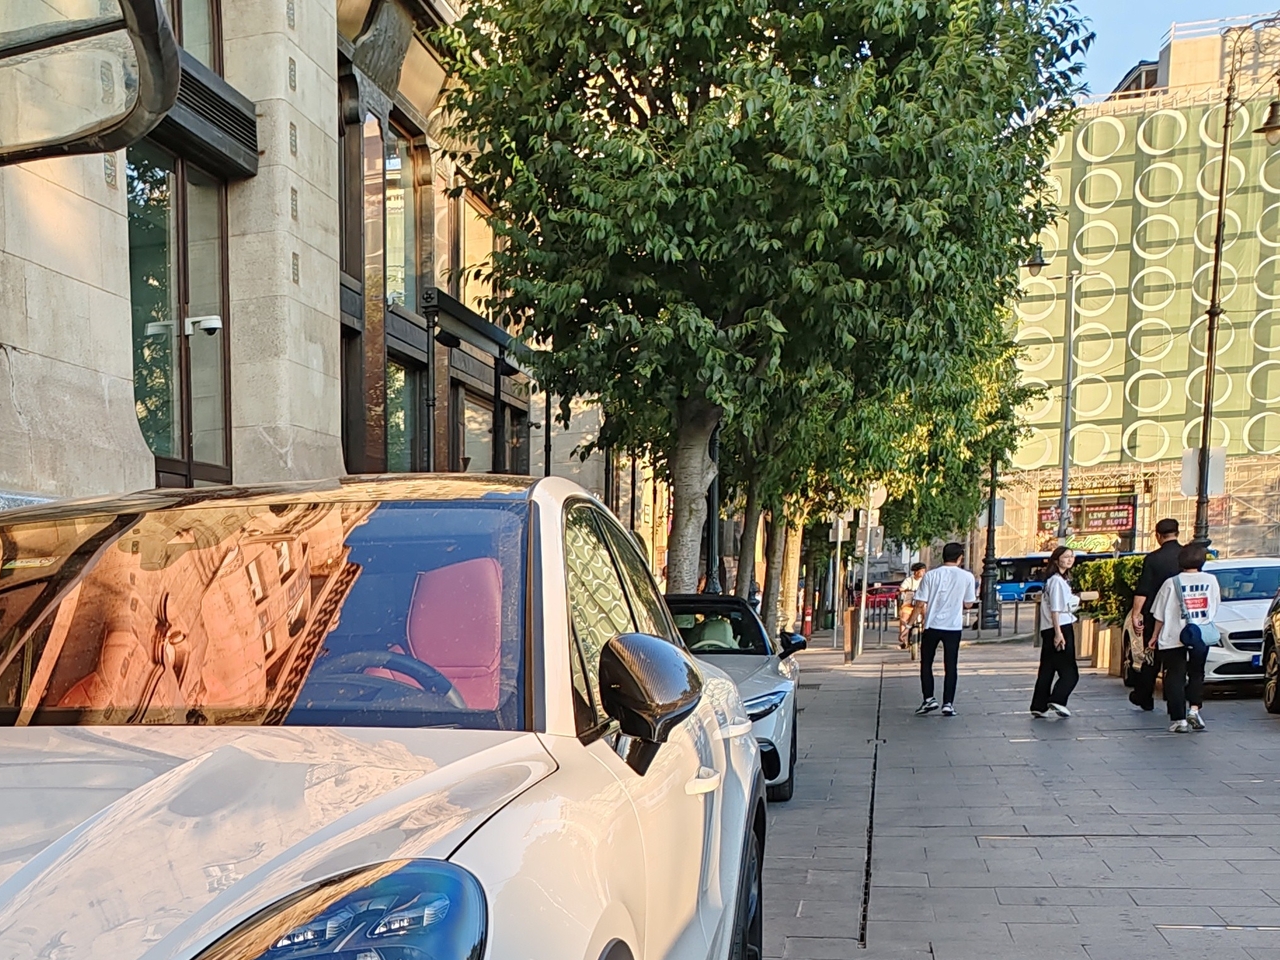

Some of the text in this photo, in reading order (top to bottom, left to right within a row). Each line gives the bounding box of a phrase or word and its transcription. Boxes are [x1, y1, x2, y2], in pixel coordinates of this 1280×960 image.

[1088, 510, 1128, 519] LIVE GAME
[1106, 518, 1127, 526] SLOTS
